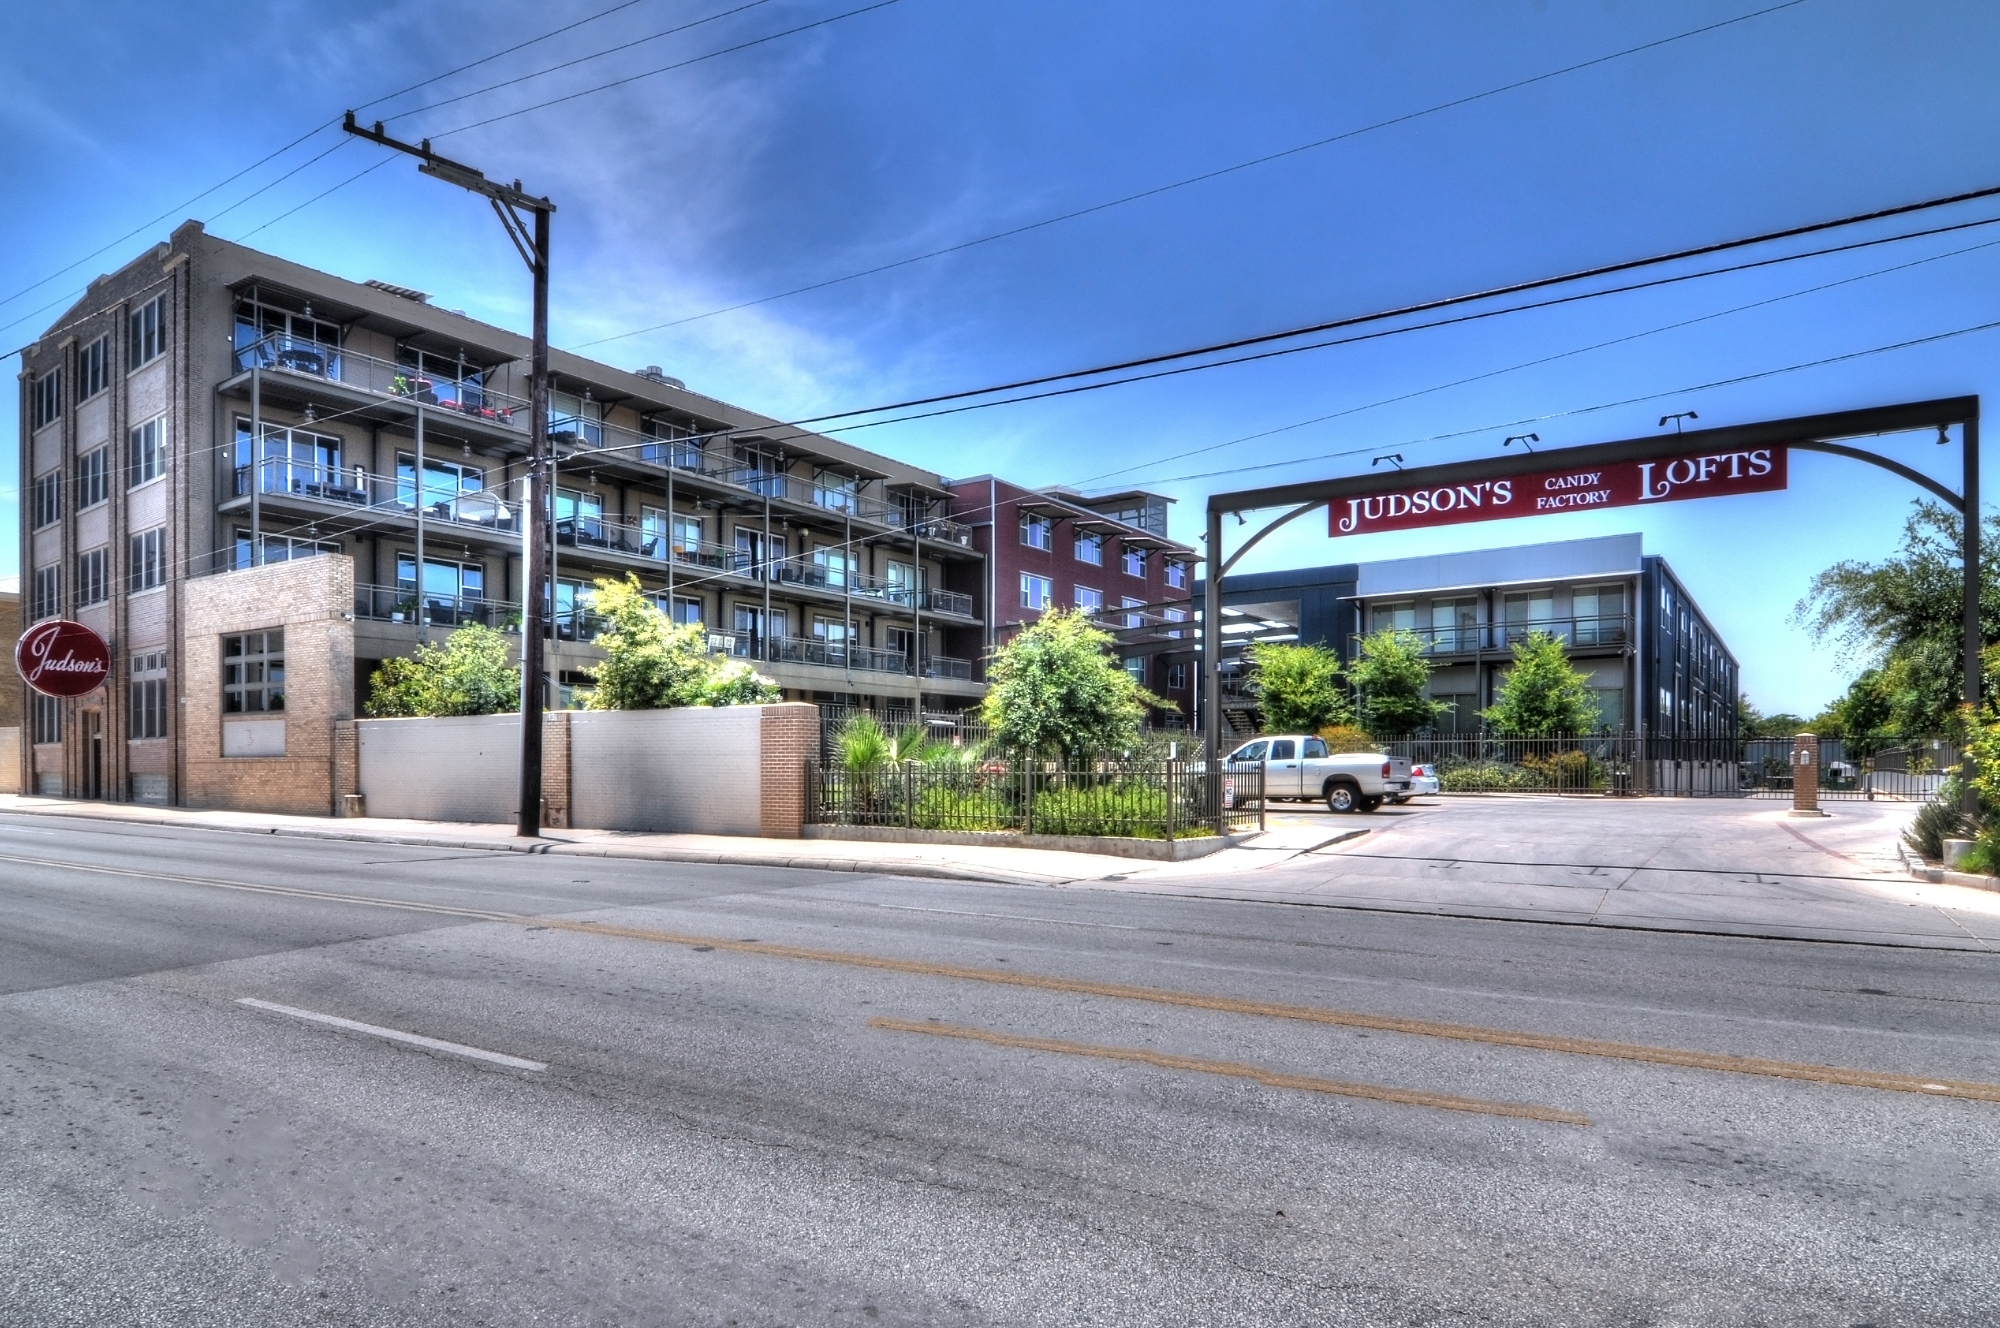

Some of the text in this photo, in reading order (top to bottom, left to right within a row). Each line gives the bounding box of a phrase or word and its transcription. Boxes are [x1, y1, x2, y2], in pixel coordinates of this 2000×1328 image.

[1535, 489, 1611, 510] FACTORY
[1544, 472, 1602, 491] CANDY
[1638, 450, 1772, 500] LOFTS
[1339, 481, 1511, 532] JUDSON'S
[30, 626, 106, 681] Judson's
